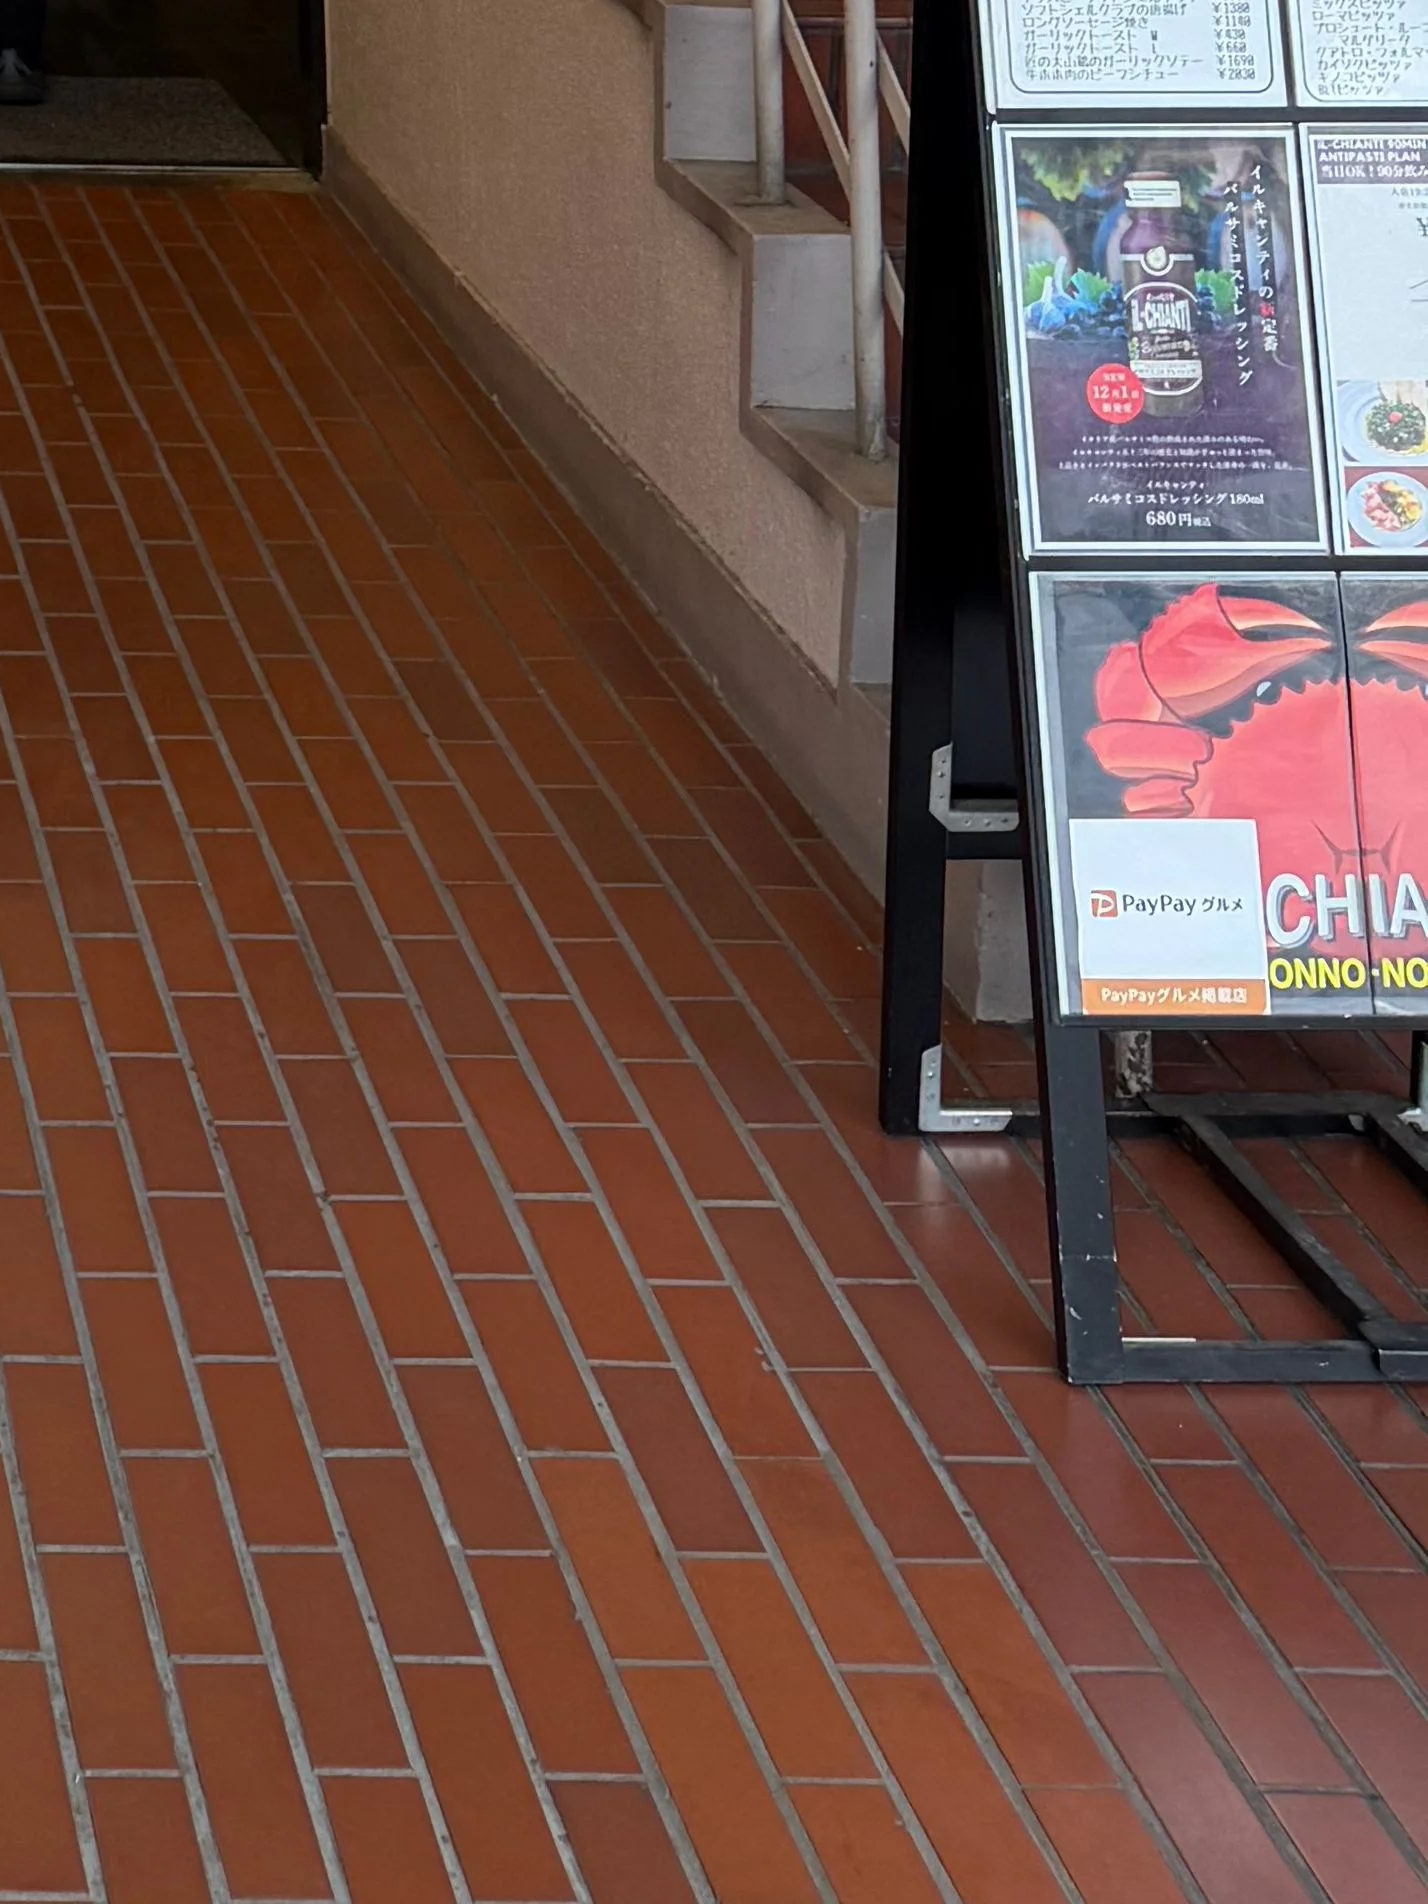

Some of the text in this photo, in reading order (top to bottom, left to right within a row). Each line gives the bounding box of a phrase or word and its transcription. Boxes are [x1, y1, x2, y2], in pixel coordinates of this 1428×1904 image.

[1387, 151, 1421, 162] PLAN
[1121, 893, 1244, 917] PayPay グルメ
